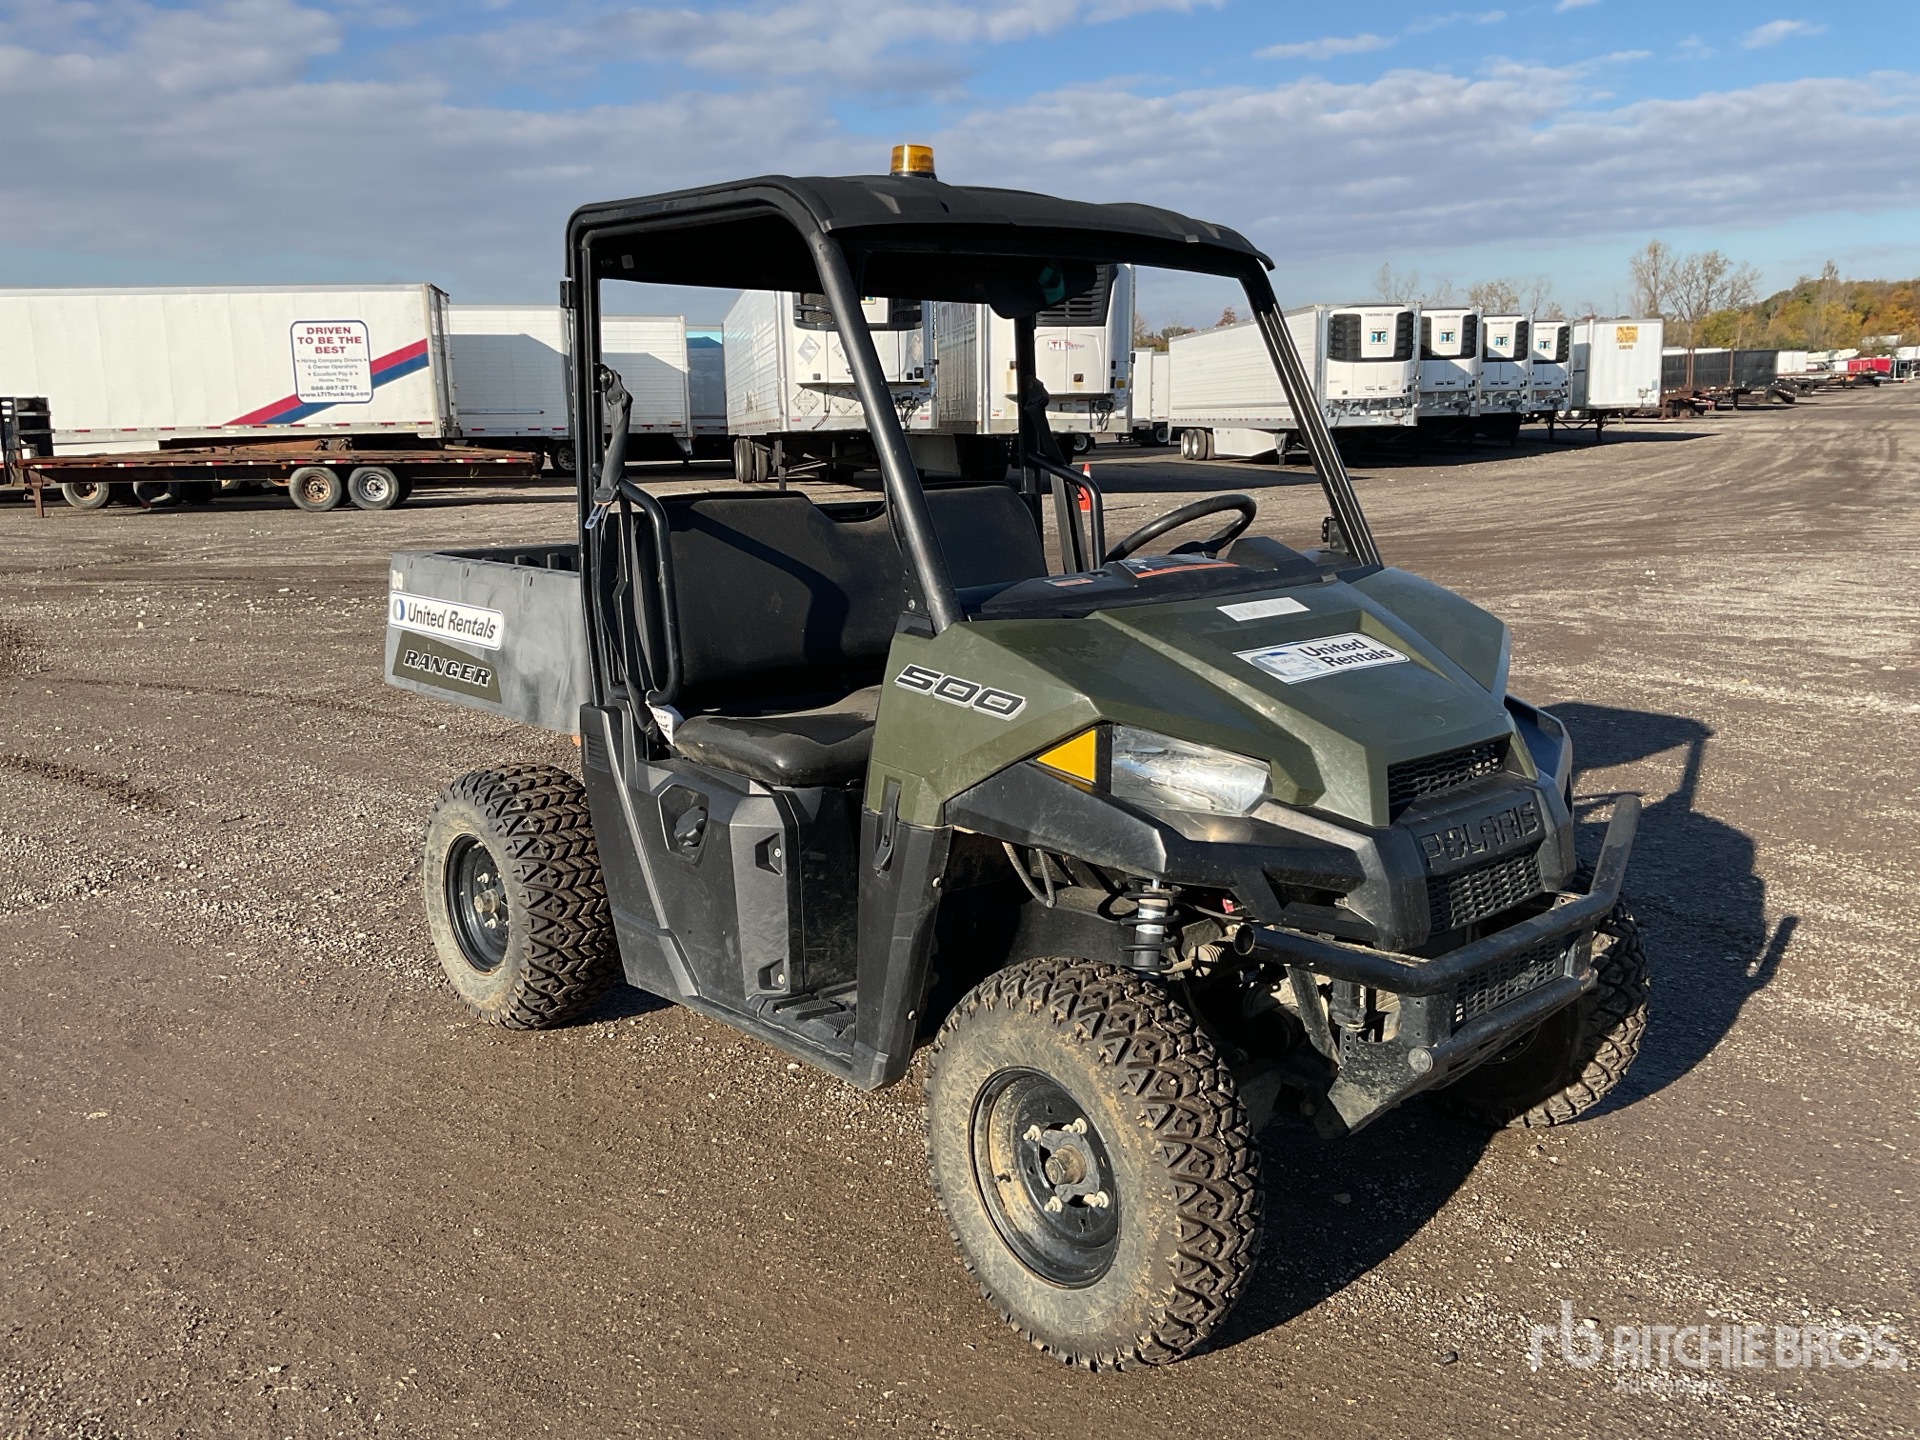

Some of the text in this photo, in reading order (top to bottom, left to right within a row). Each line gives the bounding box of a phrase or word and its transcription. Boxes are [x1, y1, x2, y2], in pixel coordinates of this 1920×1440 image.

[306, 326, 351, 335] DRIVEN
[297, 336, 362, 345] TO BE THE
[314, 346, 346, 354] BEST
[407, 602, 496, 640] United Rentals
[1298, 638, 1369, 657] United
[1316, 648, 1395, 667] Rentals
[403, 649, 492, 688] RANGER
[894, 663, 1027, 721] 500
[1419, 801, 1540, 869] POLARIS
